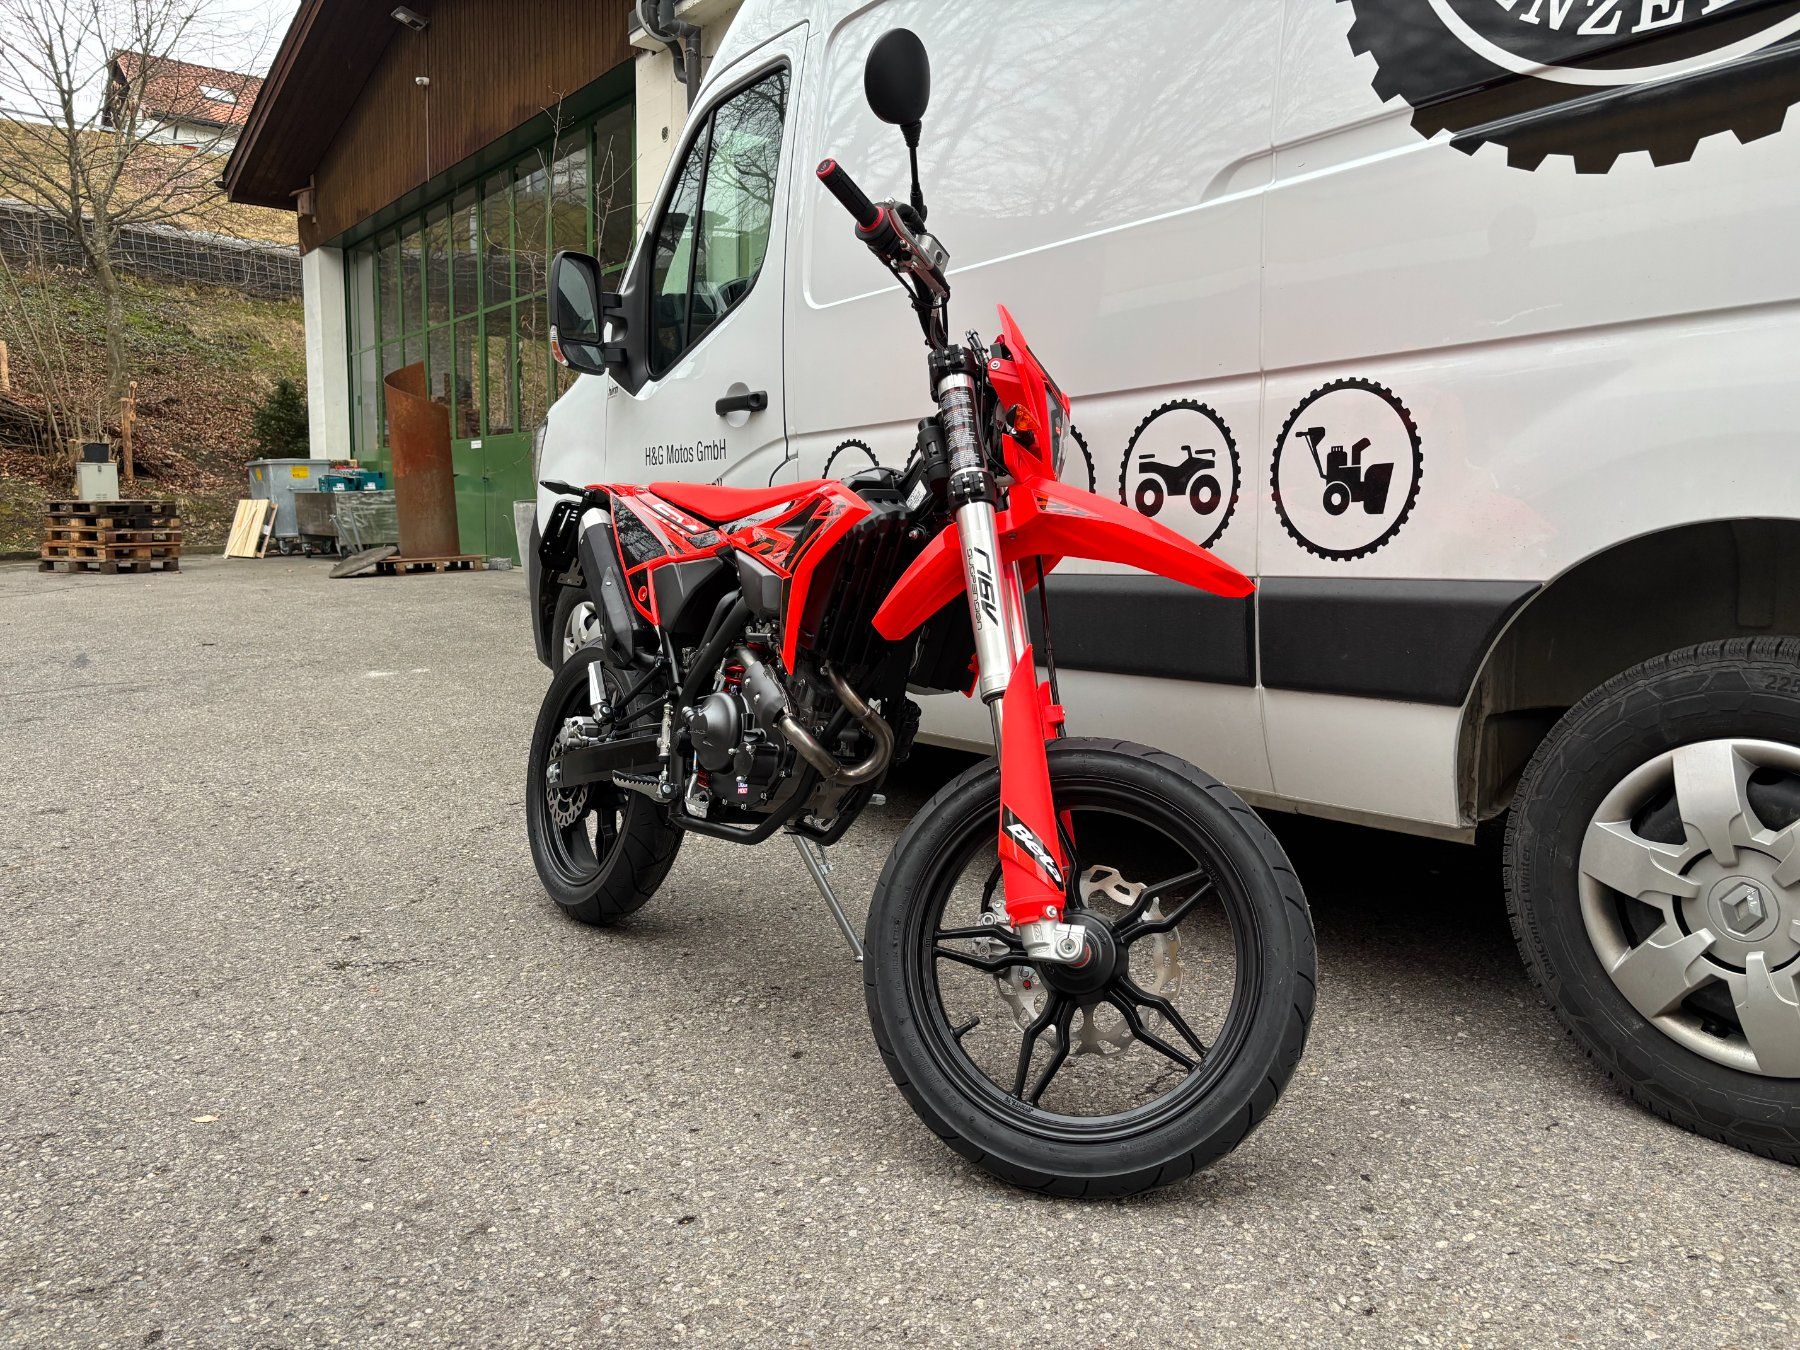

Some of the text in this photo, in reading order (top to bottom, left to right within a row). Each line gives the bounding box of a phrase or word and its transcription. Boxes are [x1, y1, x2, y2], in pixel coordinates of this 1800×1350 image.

[645, 438, 727, 466] H&G Motos GmbH
[1006, 823, 1063, 883] Beta
[1520, 849, 1531, 894] Winter
